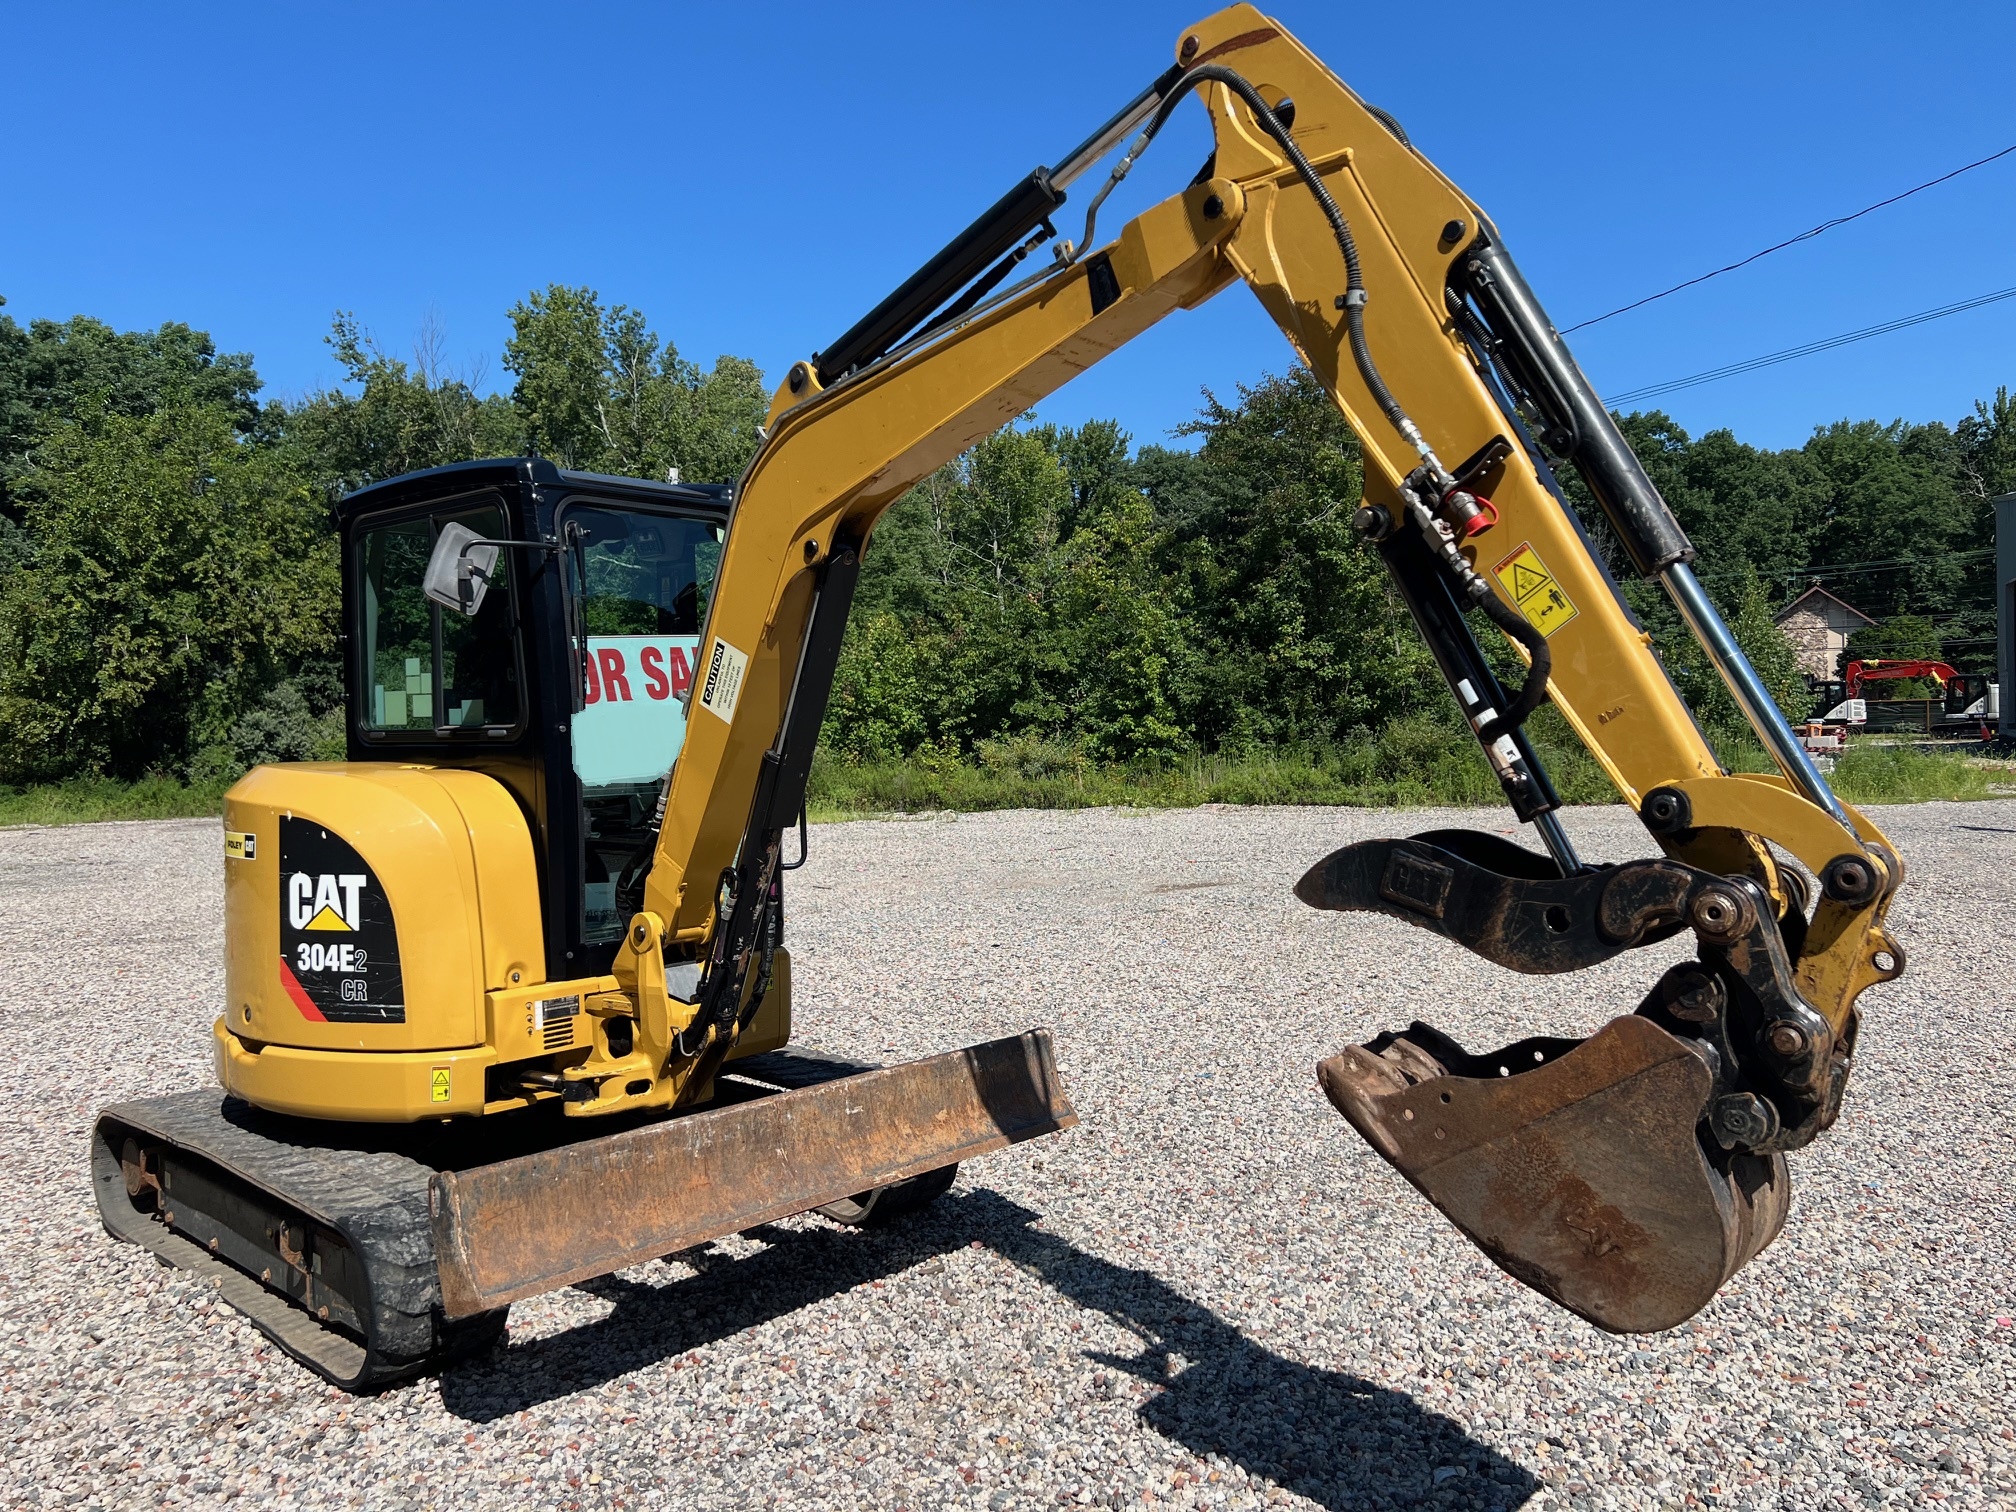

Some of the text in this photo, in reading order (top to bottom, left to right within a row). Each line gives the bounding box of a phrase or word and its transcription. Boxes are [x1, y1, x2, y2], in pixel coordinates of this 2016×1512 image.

[640, 646, 699, 700] SA
[704, 646, 723, 701] CAUTION
[227, 840, 243, 850] FOLEY
[289, 871, 367, 932] CAT
[297, 942, 367, 972] 304E2
[341, 978, 368, 1001] CR
